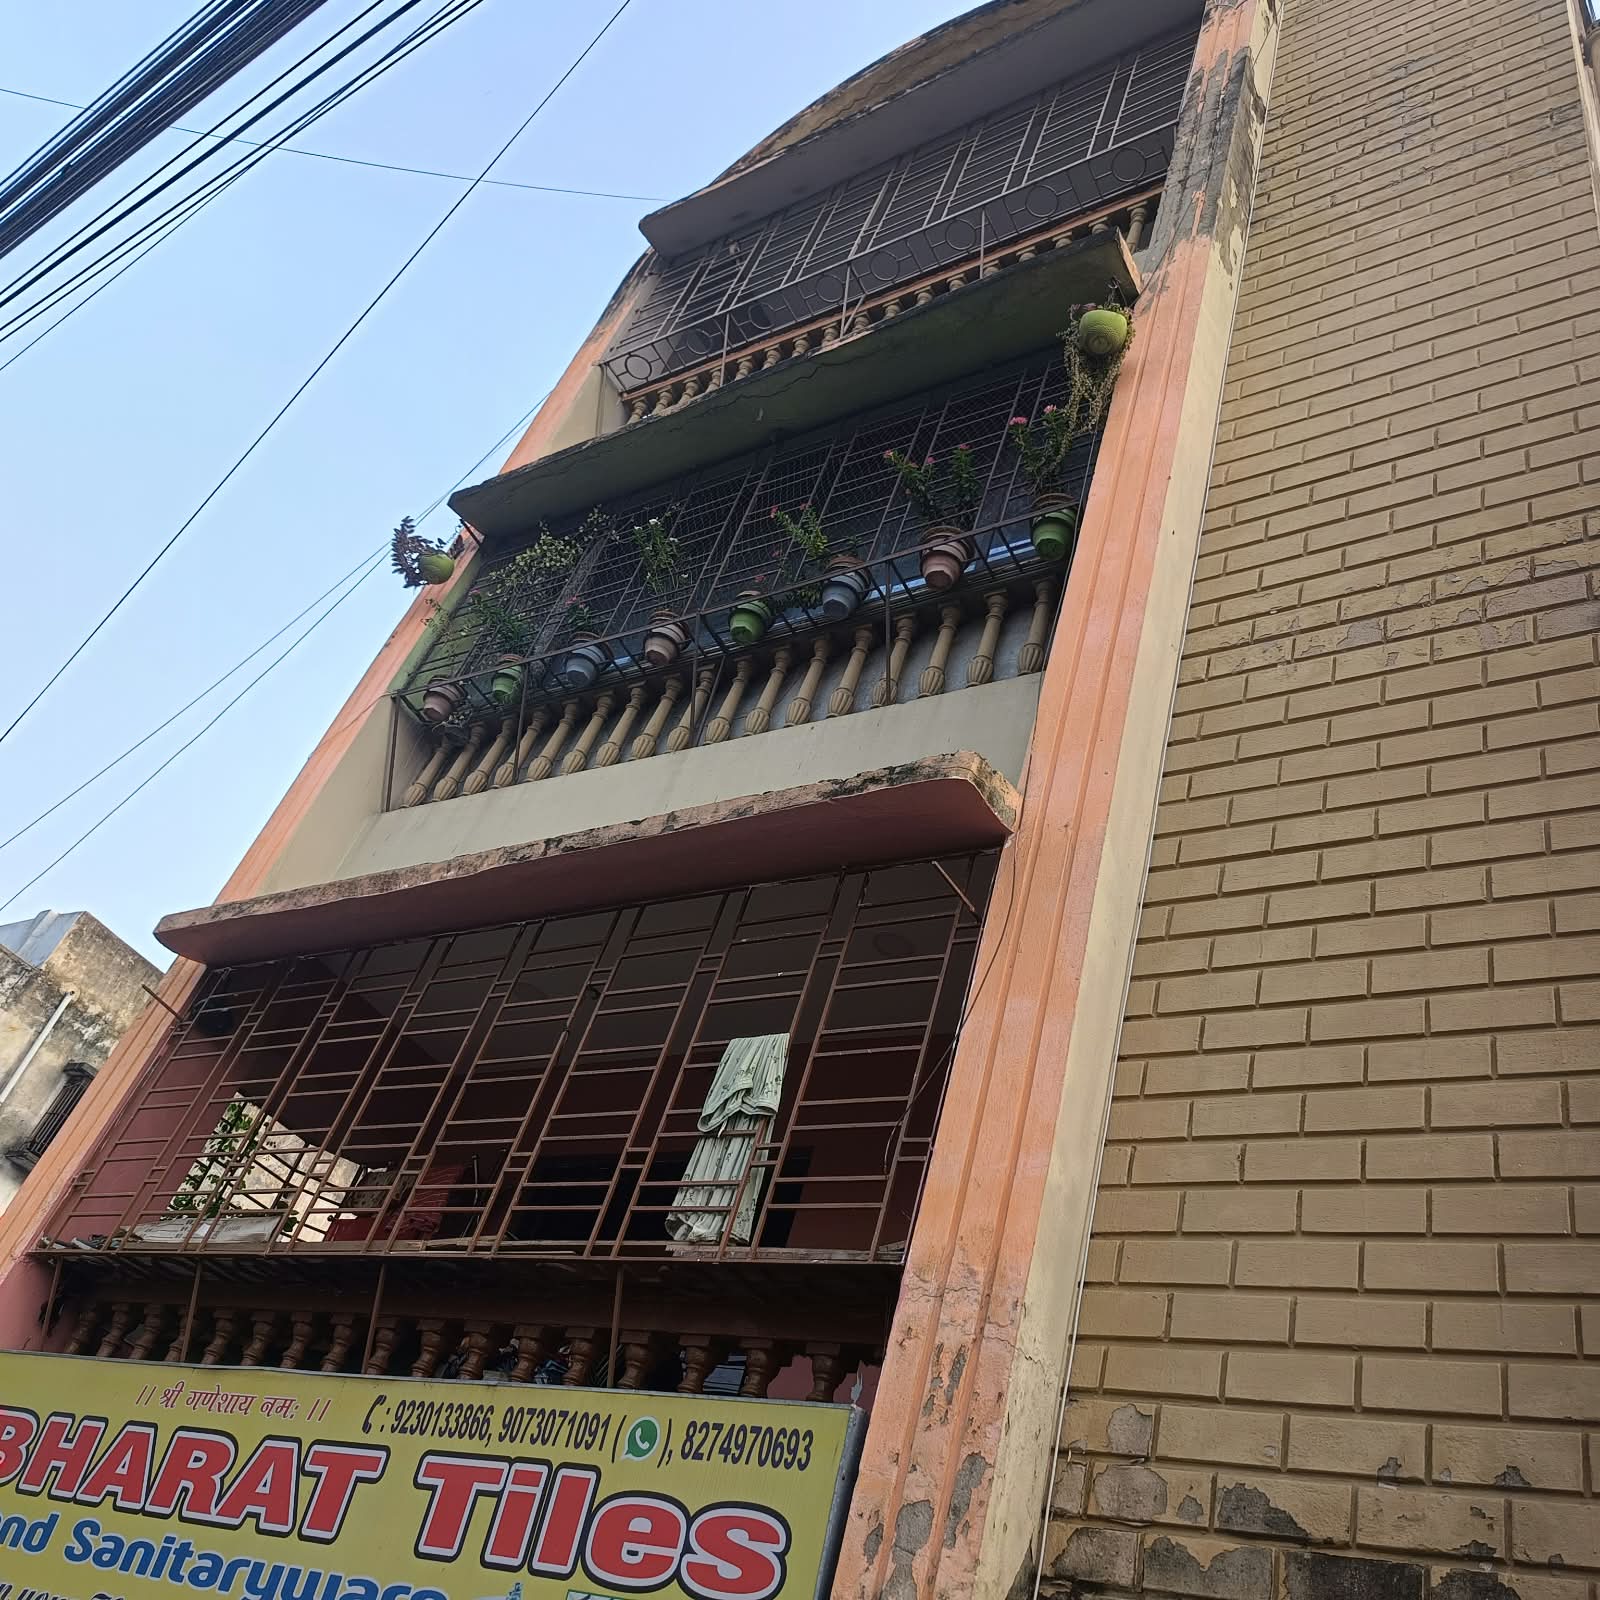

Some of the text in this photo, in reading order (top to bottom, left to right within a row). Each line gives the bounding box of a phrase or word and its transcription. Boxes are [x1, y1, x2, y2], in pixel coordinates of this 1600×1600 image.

[159, 1380, 185, 1409] श्री
[186, 1384, 258, 1415] गणेशाय
[497, 1405, 612, 1452] 9073071091
[680, 1420, 814, 1472] 8274970693
[0, 1406, 790, 1600] BHARAT Tiles
[0, 1513, 60, 1553] nd
